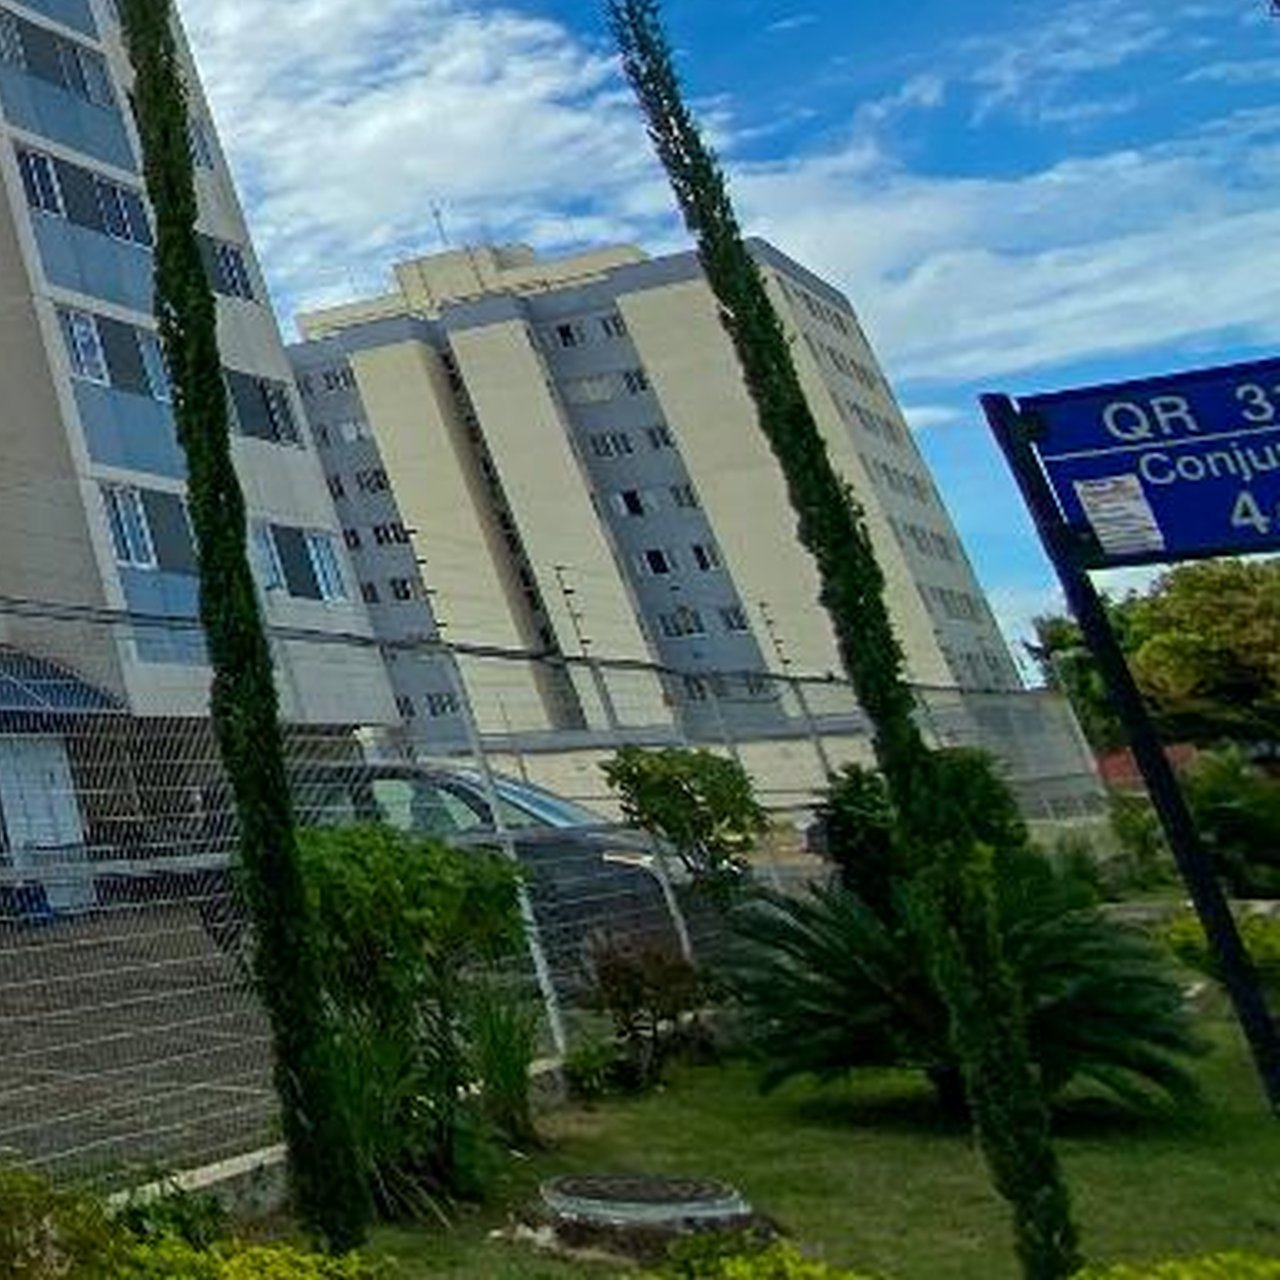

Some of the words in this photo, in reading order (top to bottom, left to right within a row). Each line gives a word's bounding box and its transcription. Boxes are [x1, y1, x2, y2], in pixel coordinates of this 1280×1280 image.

[1103, 396, 1198, 441] QR
[1236, 384, 1280, 421] 3
[1140, 442, 1280, 484] Conju
